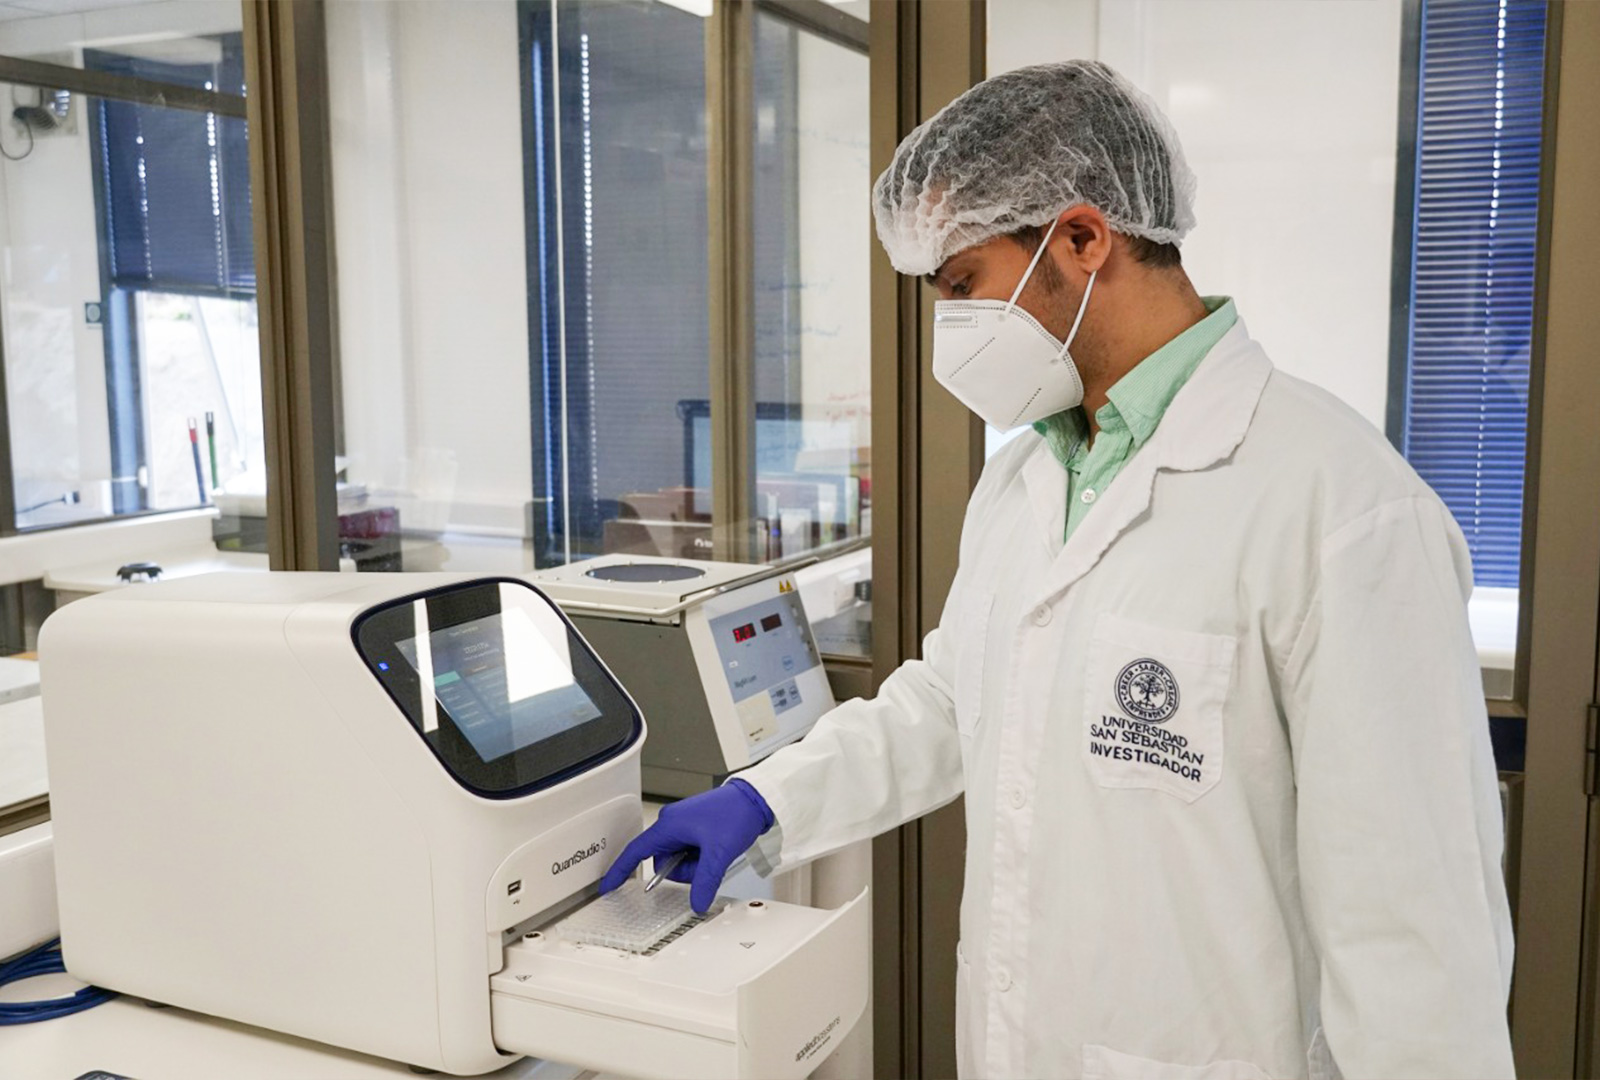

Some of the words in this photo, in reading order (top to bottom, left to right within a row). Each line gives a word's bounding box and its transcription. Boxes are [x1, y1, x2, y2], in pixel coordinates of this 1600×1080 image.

[1121, 670, 1134, 695] CREER
[1139, 664, 1164, 677] SABER
[1165, 680, 1174, 708] CREAR
[1090, 724, 1117, 740] SAN
[1121, 730, 1204, 766] SEBASTIAN
[1102, 715, 1188, 748] UNIVERSIDAD
[1090, 742, 1201, 782] INVESTIGADOR
[552, 842, 600, 875] QuantStudio
[600, 838, 607, 850] 3
